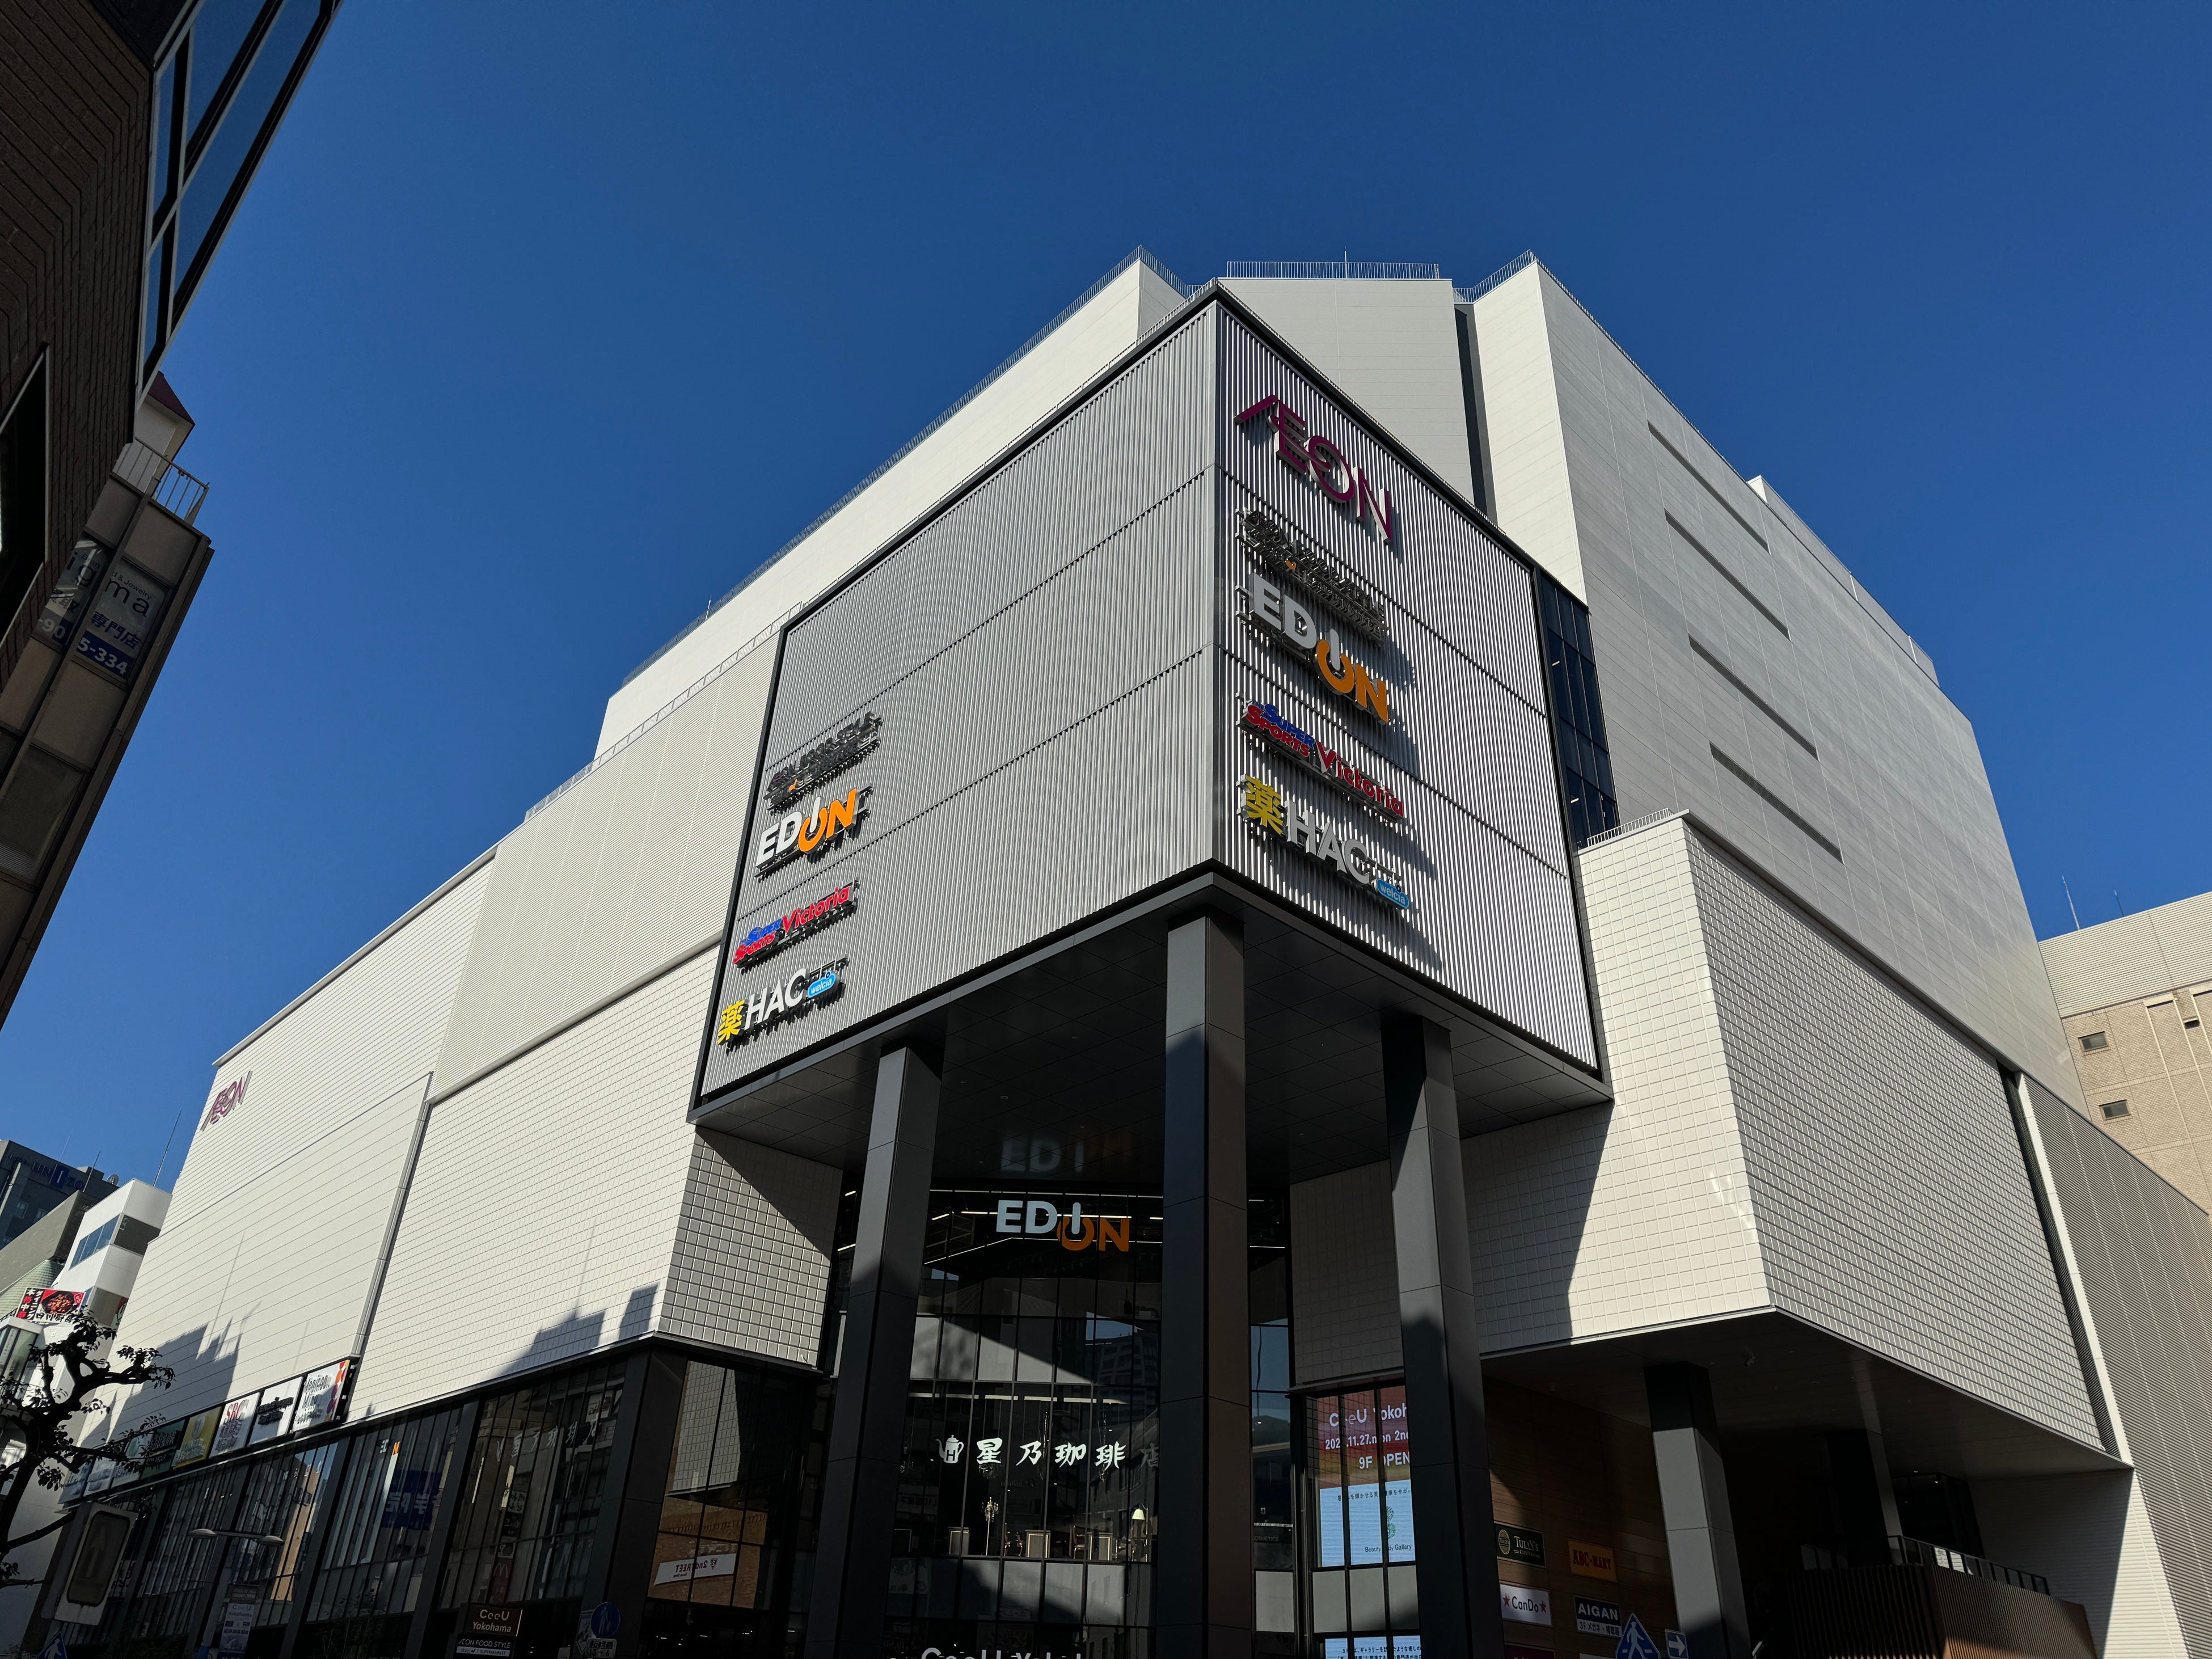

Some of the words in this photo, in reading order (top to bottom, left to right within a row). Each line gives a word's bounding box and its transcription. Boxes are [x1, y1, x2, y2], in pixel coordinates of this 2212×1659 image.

[124, 578, 152, 600] Jewelry
[91, 611, 142, 649] 専門店
[78, 637, 128, 675] 5-334
[1249, 573, 1388, 725] EDION
[1263, 703, 1315, 749] SUPER
[1243, 704, 1310, 758] SPORTS
[1316, 740, 1404, 818] Victoria
[755, 788, 858, 869] EDION
[1240, 774, 1284, 835] 薬
[1285, 800, 1370, 885] HAC
[1379, 884, 1407, 905] welcia
[782, 886, 850, 935] Victoria
[809, 978, 833, 995] welcia
[717, 999, 748, 1045] 薬
[743, 968, 810, 1031] HAC
[996, 1200, 1130, 1252] EDION
[1329, 1408, 1368, 1427] CeU
[1358, 1455, 1373, 1470] 9F
[1383, 1451, 1411, 1467] PEN
[1573, 1549, 1612, 1571] ABC-MART
[479, 1609, 510, 1622] CeeU
[1512, 1596, 1539, 1613] CanDo
[1578, 1602, 1619, 1621] AIGAN
[472, 1621, 512, 1633] Yokohama
[1579, 1622, 1586, 1630] 3F
